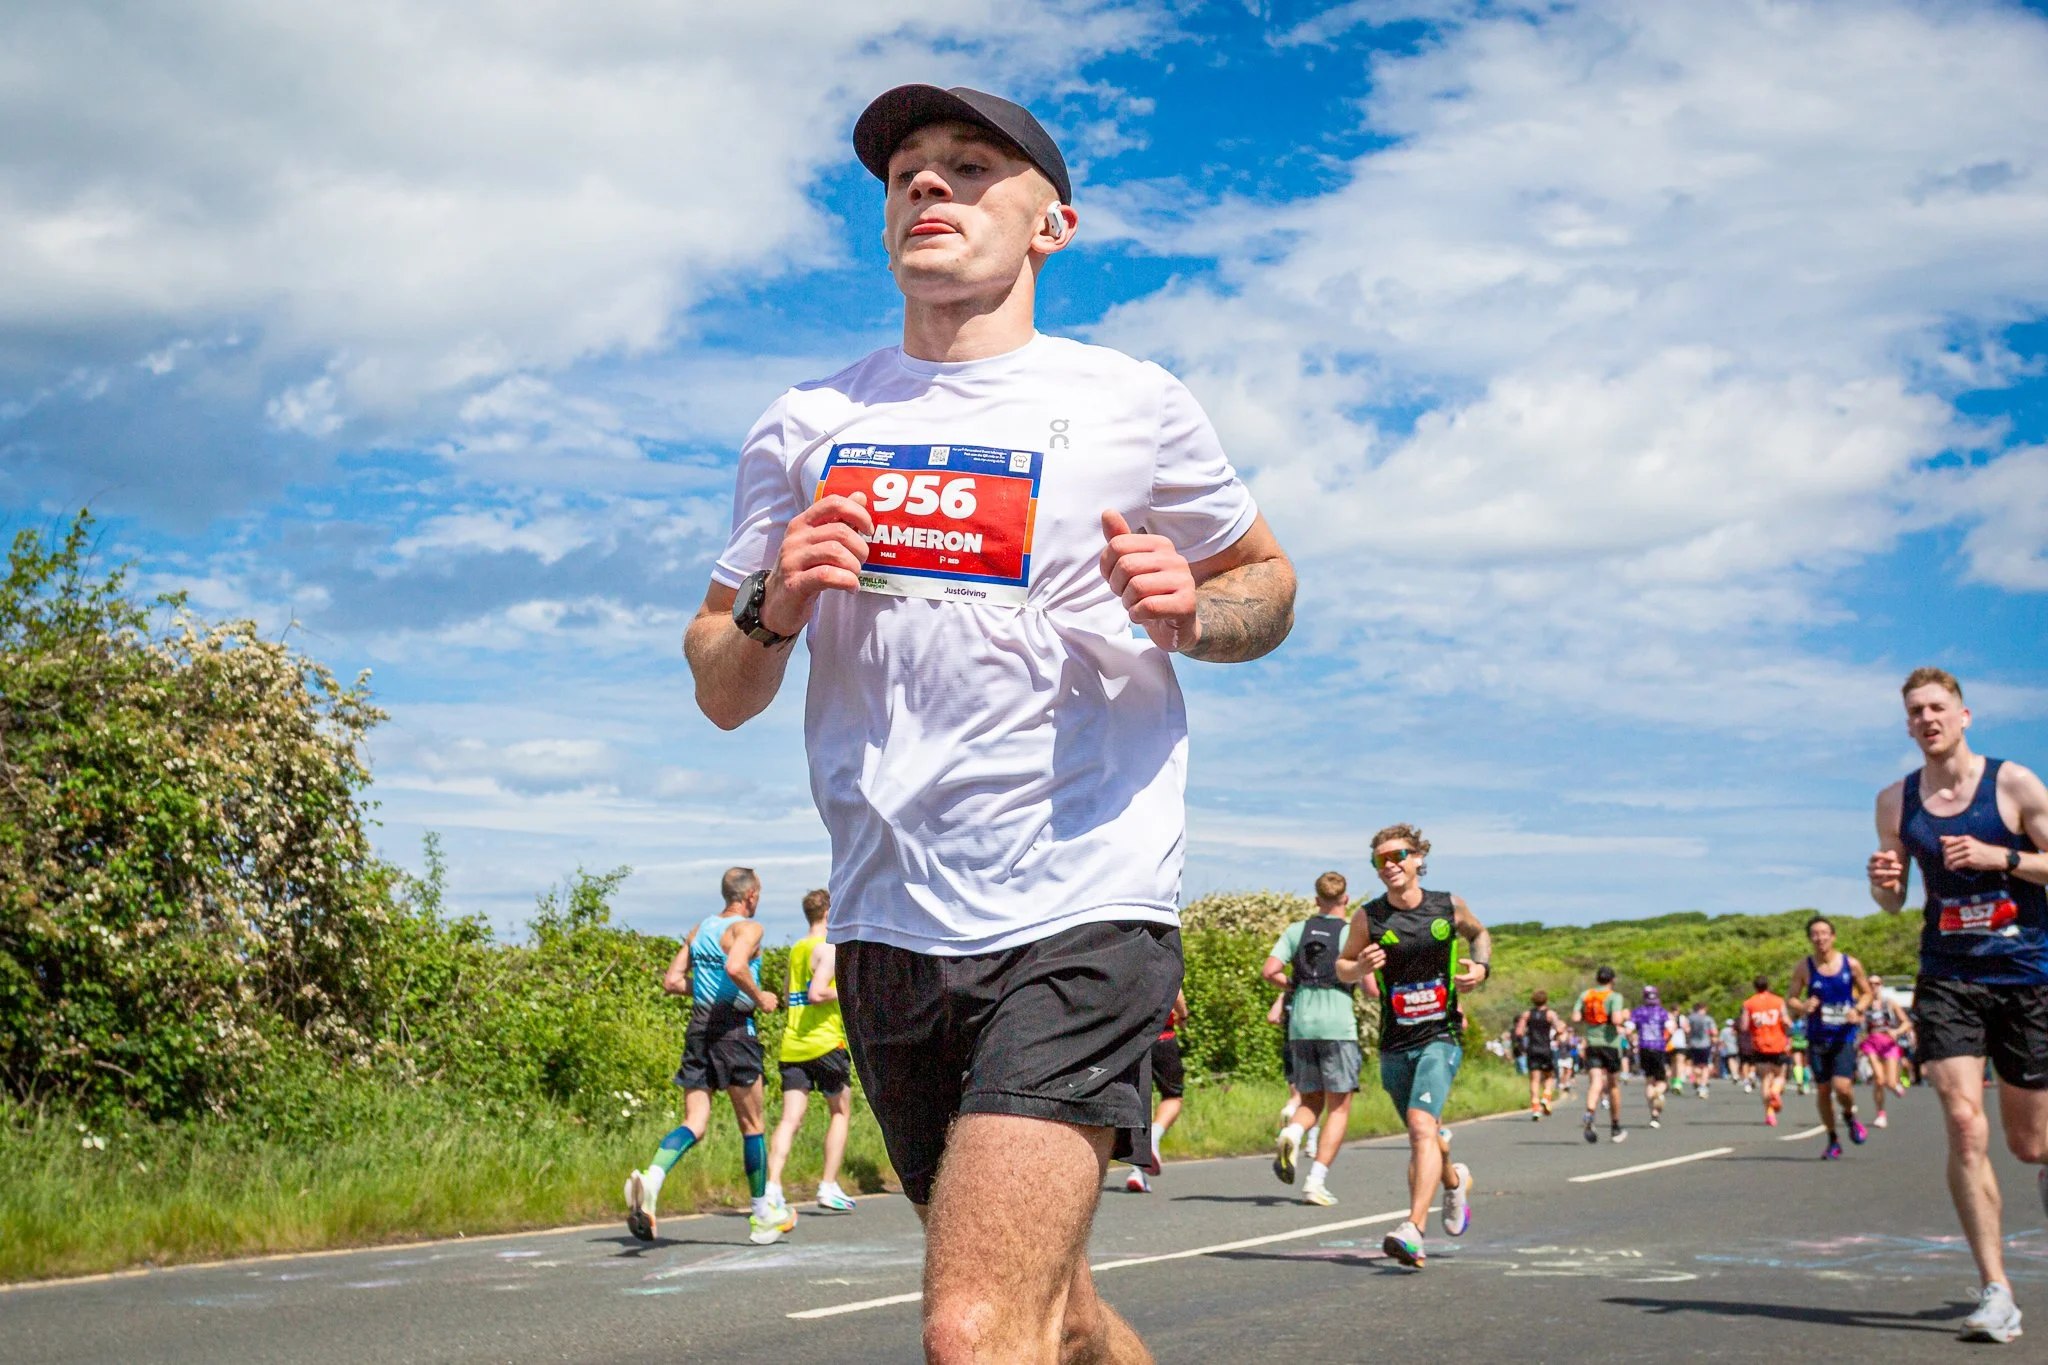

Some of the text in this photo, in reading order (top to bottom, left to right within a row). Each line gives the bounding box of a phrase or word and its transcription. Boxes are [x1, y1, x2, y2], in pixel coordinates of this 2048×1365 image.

[872, 473, 977, 519] 956
[880, 551, 897, 559] MALE
[858, 576, 888, 586] CMILLAN
[943, 586, 987, 599] JustGiving
